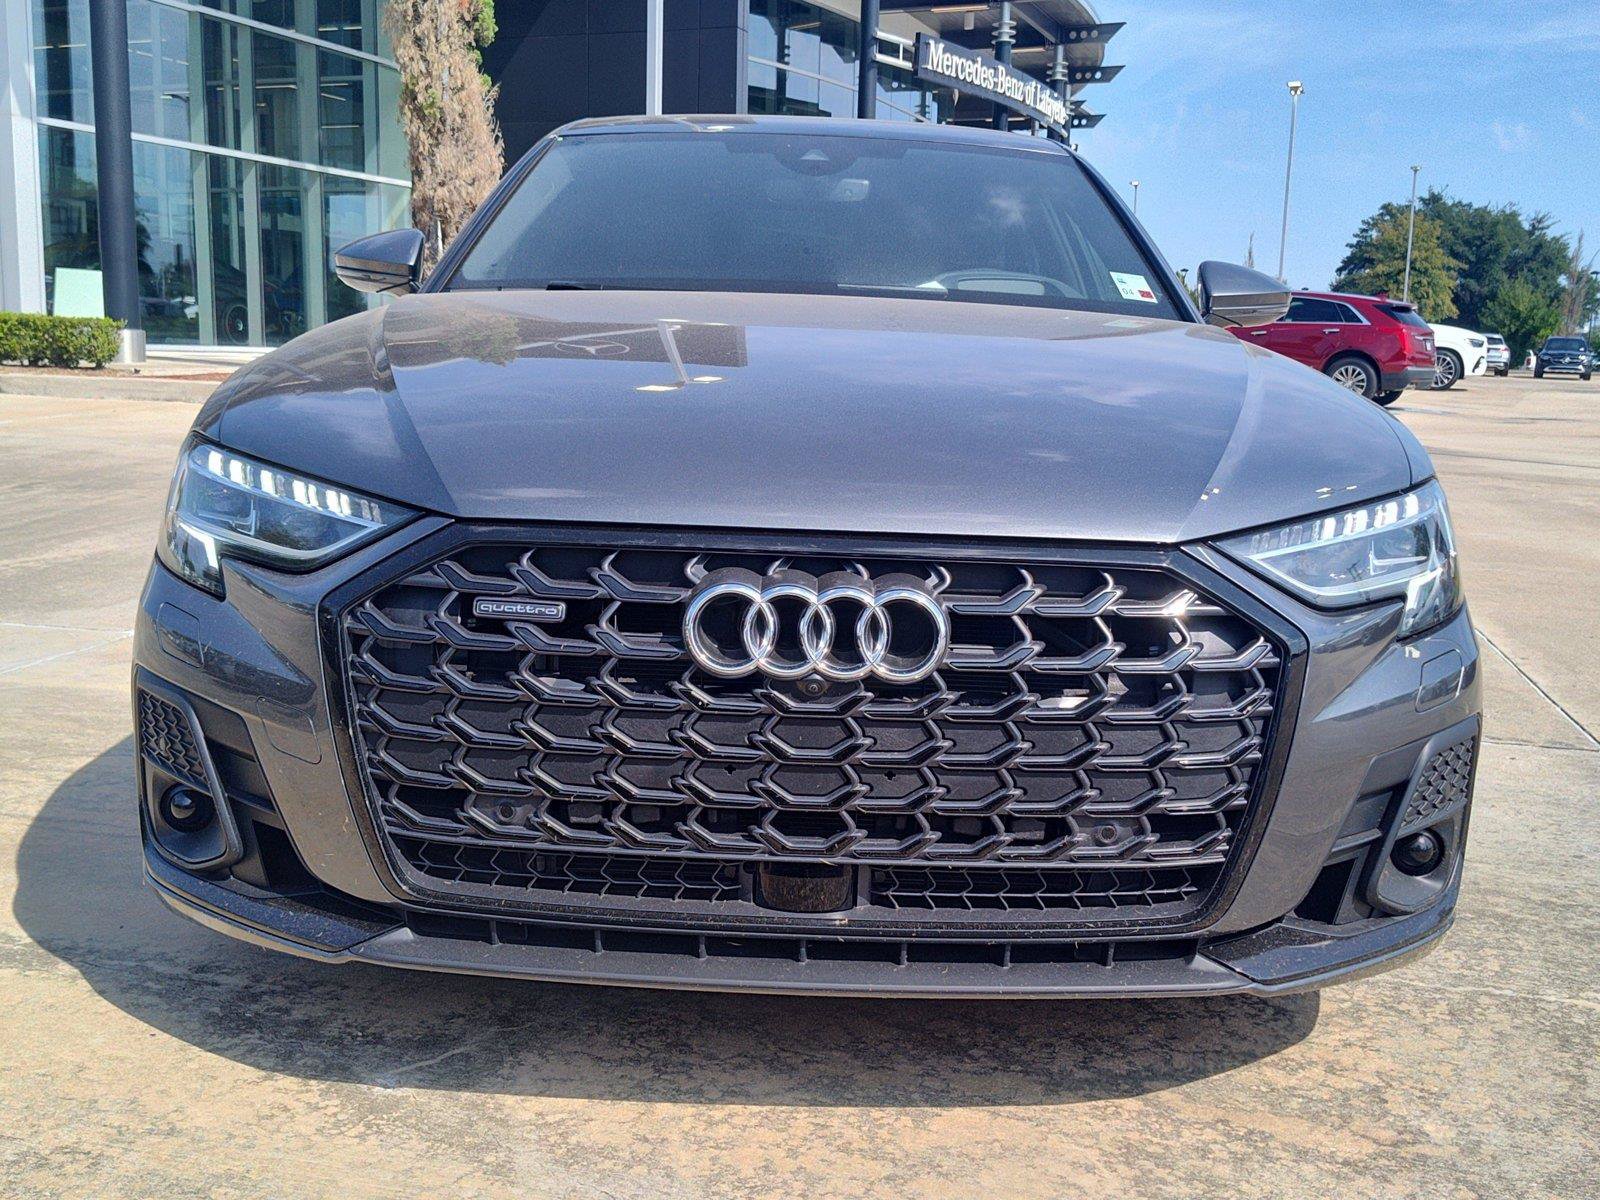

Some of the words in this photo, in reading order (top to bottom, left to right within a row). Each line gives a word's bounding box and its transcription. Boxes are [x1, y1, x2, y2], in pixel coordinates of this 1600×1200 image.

[923, 39, 1025, 101] Mercedes-Benz
[1025, 80, 1037, 106] of
[480, 603, 557, 615] quattro
